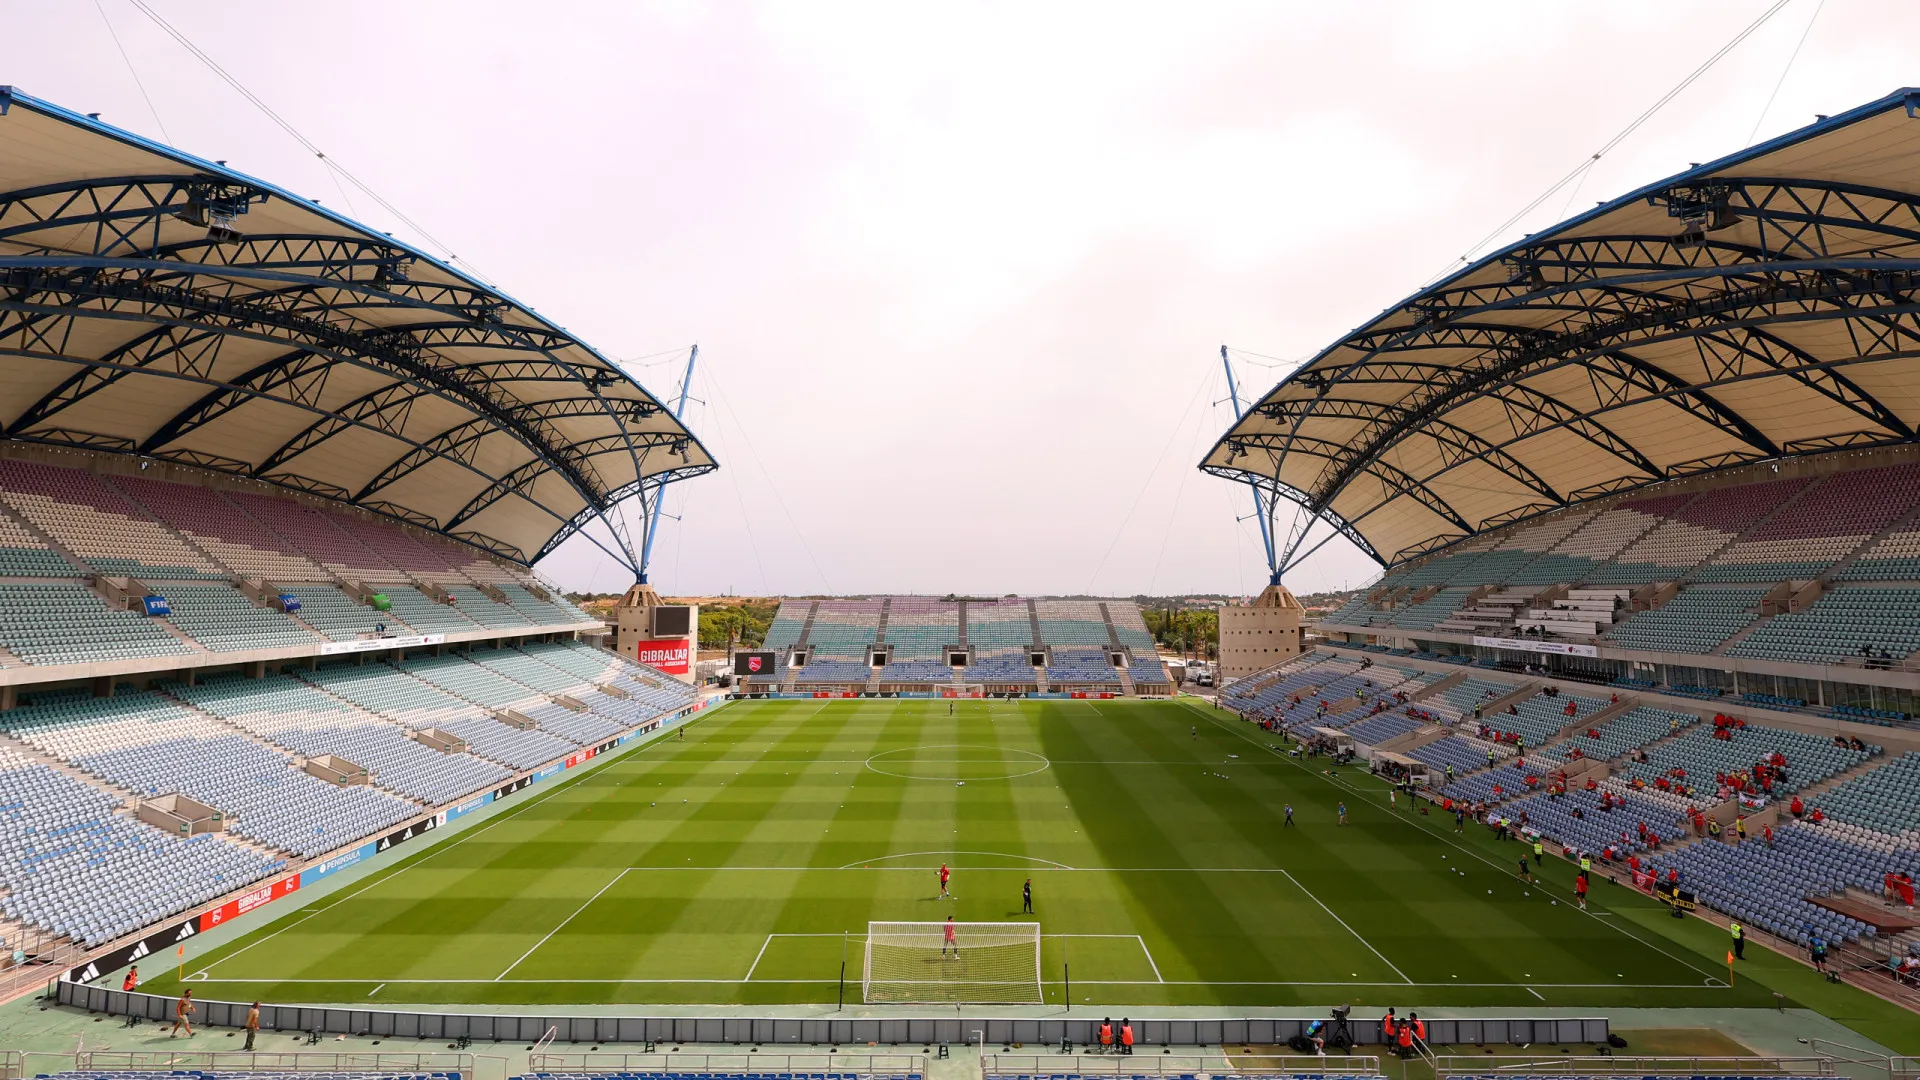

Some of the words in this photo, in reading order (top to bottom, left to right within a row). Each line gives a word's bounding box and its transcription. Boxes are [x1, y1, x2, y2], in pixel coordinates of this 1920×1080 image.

[641, 648, 688, 662] GIBRALTAR
[326, 850, 360, 871] PENINSULA
[238, 886, 272, 909] GIBRALTAR
